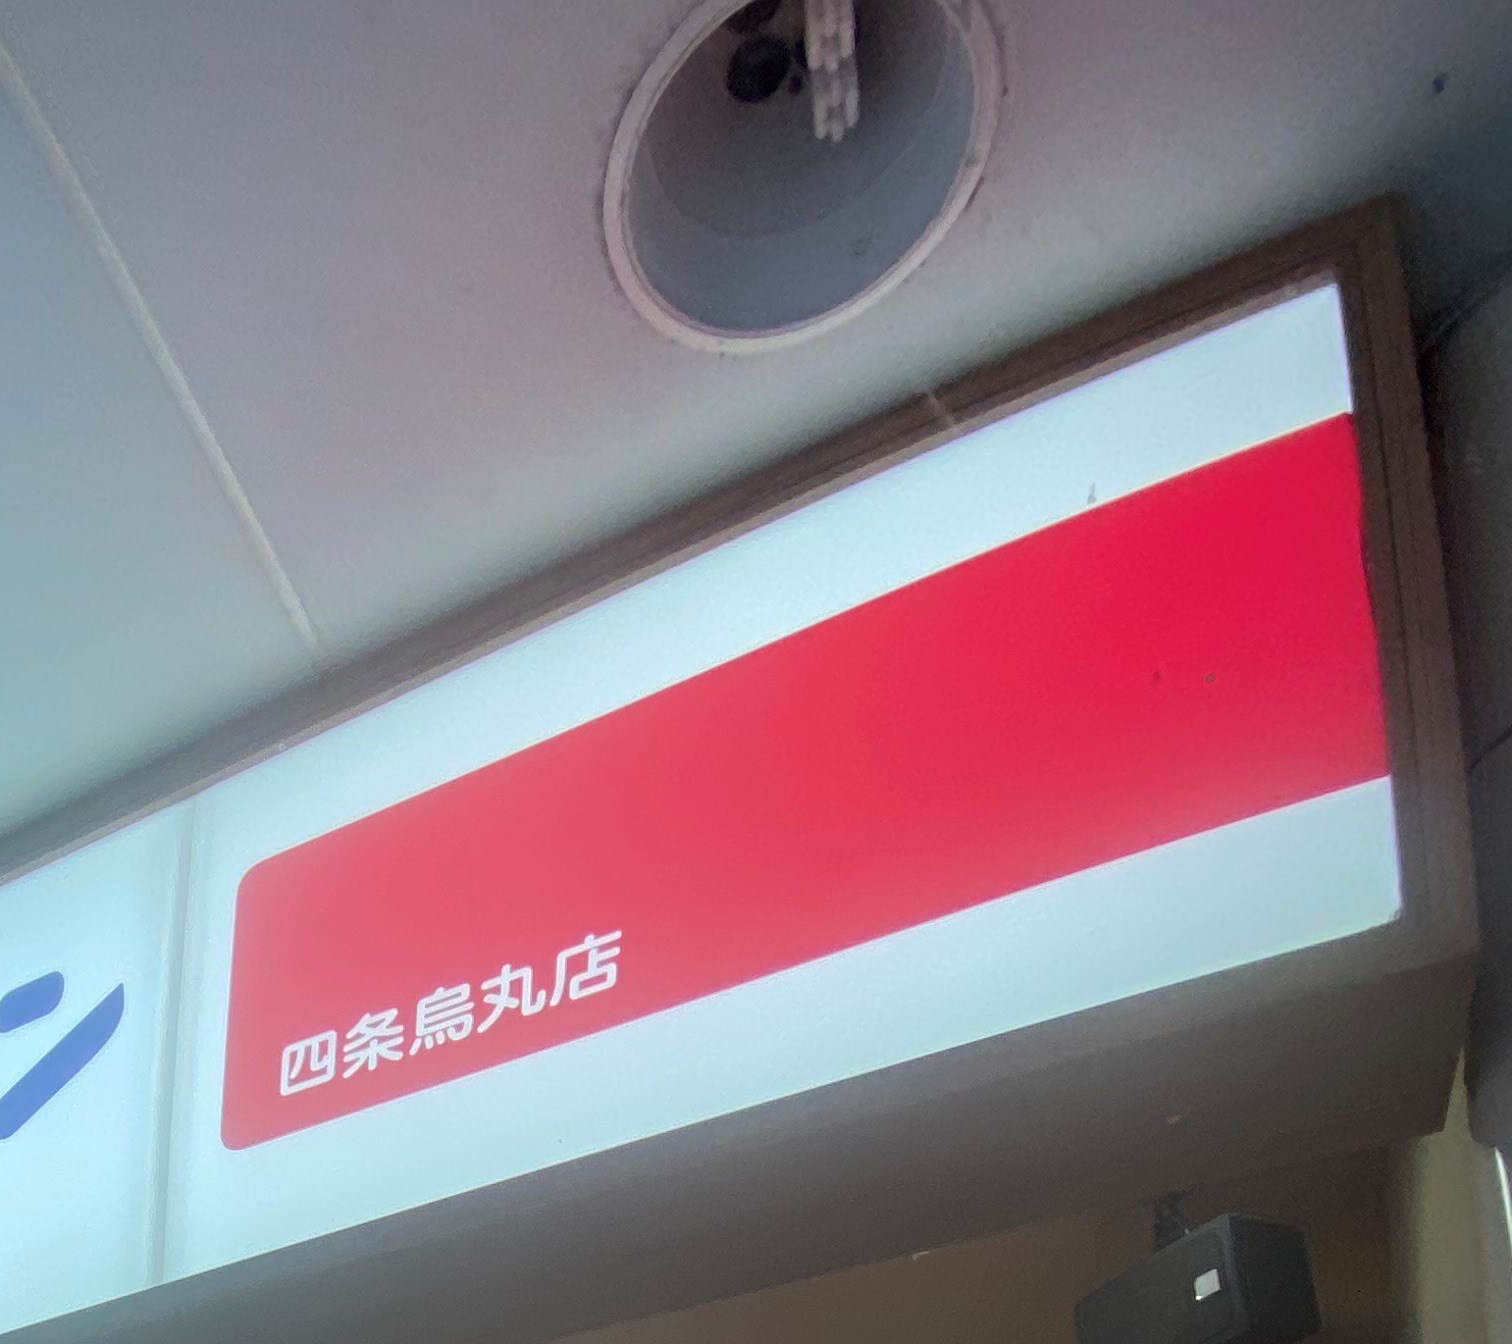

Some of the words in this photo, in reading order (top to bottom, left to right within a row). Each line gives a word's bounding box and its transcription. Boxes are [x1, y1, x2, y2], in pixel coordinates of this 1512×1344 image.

[279, 929, 623, 1097] 四条烏丸店
